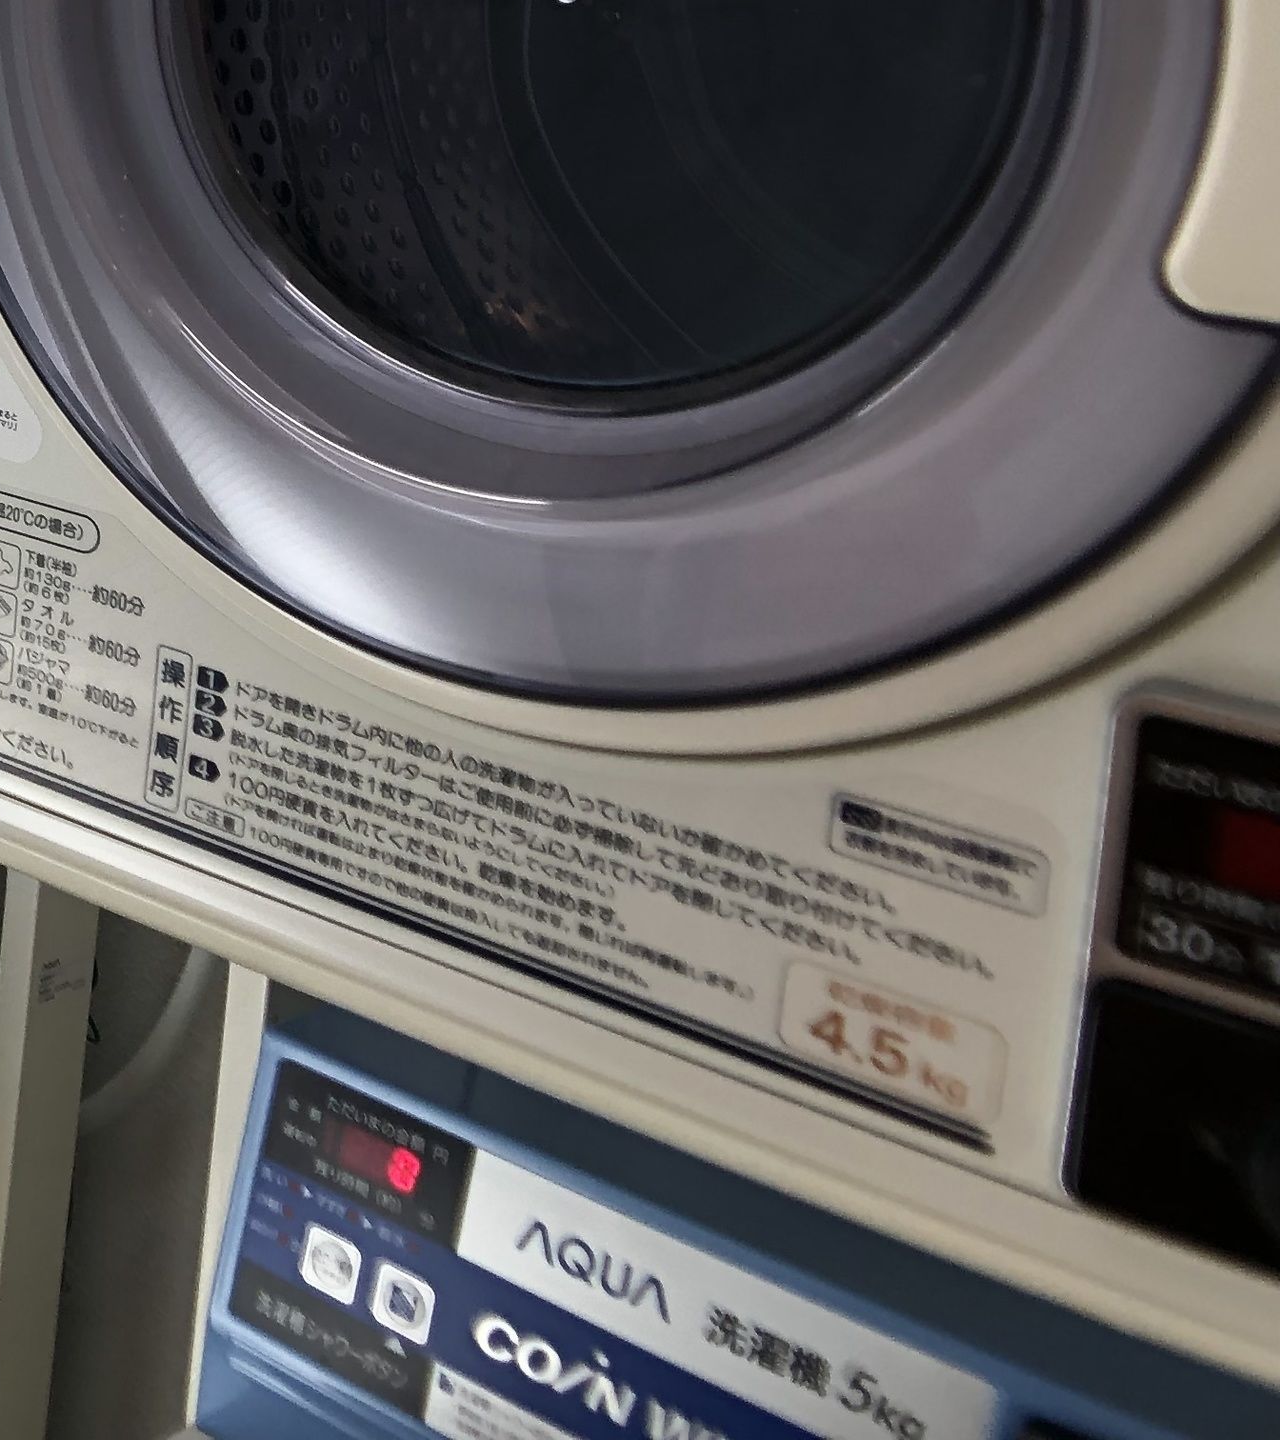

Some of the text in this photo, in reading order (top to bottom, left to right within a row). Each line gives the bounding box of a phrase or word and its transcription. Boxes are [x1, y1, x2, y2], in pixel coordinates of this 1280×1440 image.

[516, 1218, 673, 1325] AQUA
[705, 1304, 832, 1398] 洗濯機
